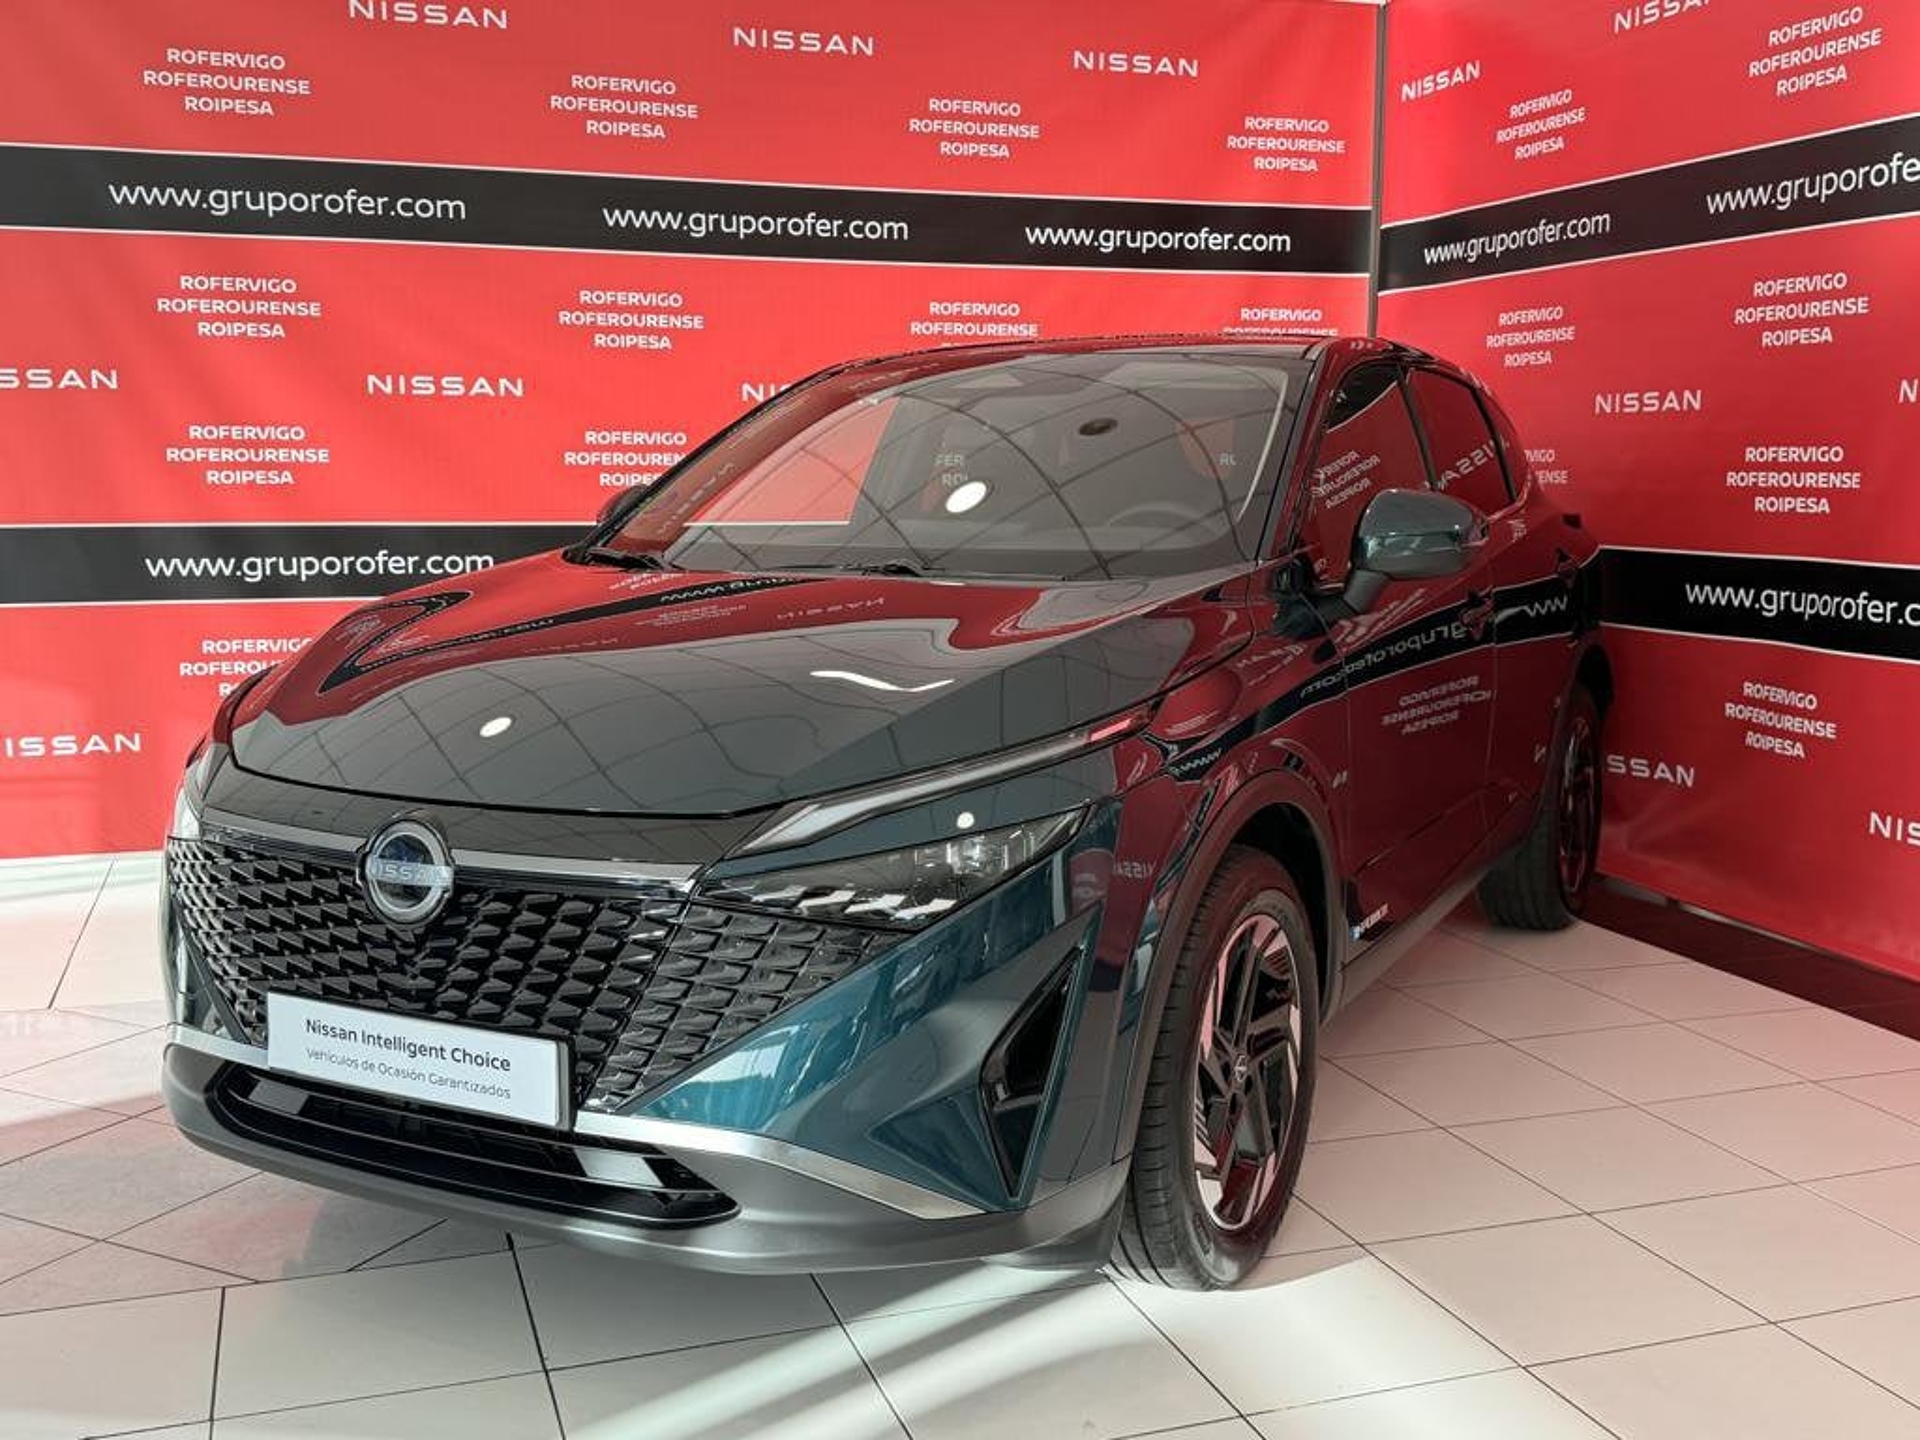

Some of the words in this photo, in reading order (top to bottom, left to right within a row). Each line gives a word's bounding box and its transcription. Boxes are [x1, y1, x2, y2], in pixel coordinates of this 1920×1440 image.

[349, 0, 507, 29] NISSAN
[1614, 0, 1709, 34] NISS
[1770, 7, 1862, 45] ROFERVIGO
[734, 28, 872, 55] NISSAN
[1750, 28, 1881, 76] ROFEROURENSE
[167, 49, 285, 69] ROFERVIGO
[1074, 51, 1197, 76] NISSAN
[144, 71, 310, 94] ROFEROURENSE
[572, 75, 675, 94] ROFERVIGO
[1402, 63, 1479, 101] NISSAN
[1777, 65, 1847, 95] ROIPESA
[185, 96, 273, 114] ROIPESA
[551, 96, 697, 118] ROFEROURENSE
[930, 99, 1020, 116] ROFERVIGO
[1510, 90, 1572, 118] ROFERVIGO
[587, 120, 665, 138] ROIPESA
[910, 119, 1038, 137] ROFEROURENSE
[1245, 117, 1329, 132] ROFERVIGO
[1497, 107, 1585, 142] ROFEROURENSE
[941, 142, 1009, 157] ROIPESA
[1228, 136, 1344, 152] ROFEROURENSE
[1515, 137, 1564, 159] ROIPESA
[1254, 157, 1318, 171] ROIPESA
[1706, 152, 1920, 215] www.gruporofe
[109, 185, 465, 219] www.gruporofer.com
[603, 209, 908, 239] www.gruporofer.com
[1026, 227, 1290, 253] www.gruporofer.com
[1424, 214, 1610, 264] www.gruporofer.com
[181, 276, 296, 293] ROFERVIGO
[1754, 273, 1847, 296] ROFERVIGO
[158, 299, 320, 315] ROFEROURENSE
[580, 291, 682, 307] ROFERVIGO
[930, 302, 1020, 316] ROFERVIGO
[559, 311, 703, 328] ROFEROURENSE
[1241, 308, 1322, 321] ROFERVIGO
[1499, 306, 1562, 326] ROFERVIGO
[1735, 297, 1868, 323] ROFEROURENSE
[198, 322, 285, 337] ROIPESA
[911, 322, 1037, 336] ROFEROURENSE
[1487, 326, 1575, 347] ROFEROURENSE
[1762, 327, 1832, 346] ROIPESA
[595, 334, 671, 349] ROIPESA
[1505, 351, 1552, 366] ROIPESA
[0, 368, 119, 389] SSAN
[368, 375, 522, 396] NISSAN
[1596, 390, 1701, 413] NISSAN
[189, 426, 305, 440] ROFERVIGO
[584, 431, 687, 445] ROFERVIGO
[167, 448, 329, 463] ROFEROURENSE
[564, 452, 685, 465] ROFEROUREN
[1746, 446, 1843, 462] ROFERVIGO
[207, 471, 294, 484] ROIPESA
[600, 473, 663, 486] ROIPE
[1727, 472, 1860, 488] ROFEROURENSE
[1755, 497, 1830, 513] ROIPESA
[1686, 584, 1920, 627] www.gruporofer.c
[202, 638, 312, 653] ROFERVIG
[1744, 682, 1817, 710] ROFERVIGO
[1726, 703, 1836, 738] ROFEROURENSE
[5, 733, 141, 758] ISSAN
[1746, 732, 1804, 758] ROIPESA
[1608, 756, 1694, 787] SSAN
[1869, 811, 1920, 847] NIS
[306, 1018, 357, 1042] Nissan
[361, 1029, 447, 1061] Intelligent
[450, 1047, 511, 1072] Choice
[361, 1059, 377, 1073] de
[428, 1071, 511, 1099] Garantizados
